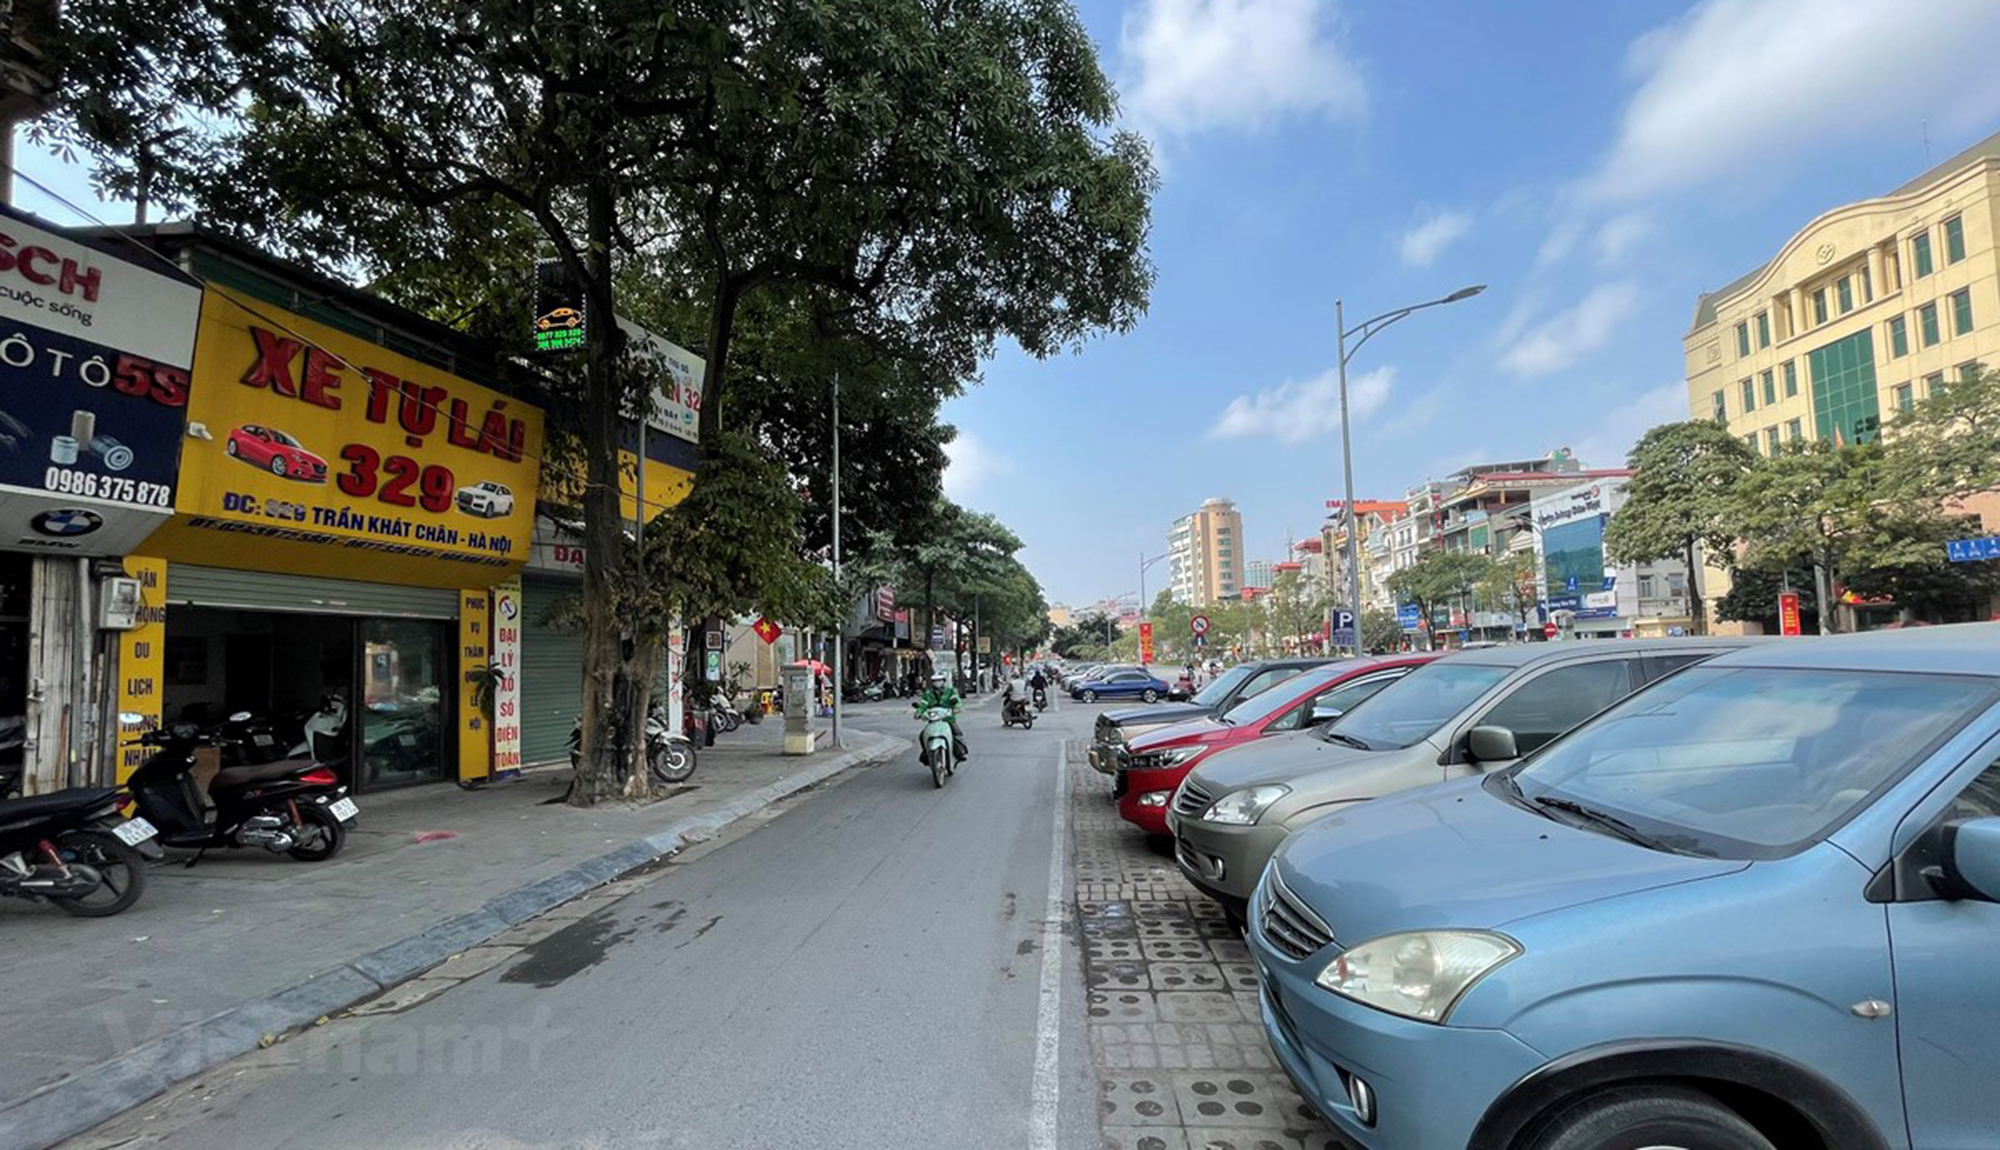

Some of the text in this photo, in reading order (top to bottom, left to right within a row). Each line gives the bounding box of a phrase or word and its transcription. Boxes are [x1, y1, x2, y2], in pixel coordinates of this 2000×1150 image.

[49, 302, 92, 327] sống
[113, 353, 188, 406] 5S
[240, 326, 525, 463] XE TỰ LÁI
[45, 466, 170, 507] 0986 375 878
[337, 443, 454, 513] 329
[368, 517, 411, 537] KHÁT
[415, 524, 458, 545] CHÂN
[468, 531, 486, 549] HÀ
[489, 535, 511, 556] NỘI
[1340, 612, 1353, 627] P
[499, 628, 517, 646] ĐẠI
[134, 642, 150, 658] DU
[501, 649, 514, 667] LÝ
[127, 678, 153, 698] LỊCH
